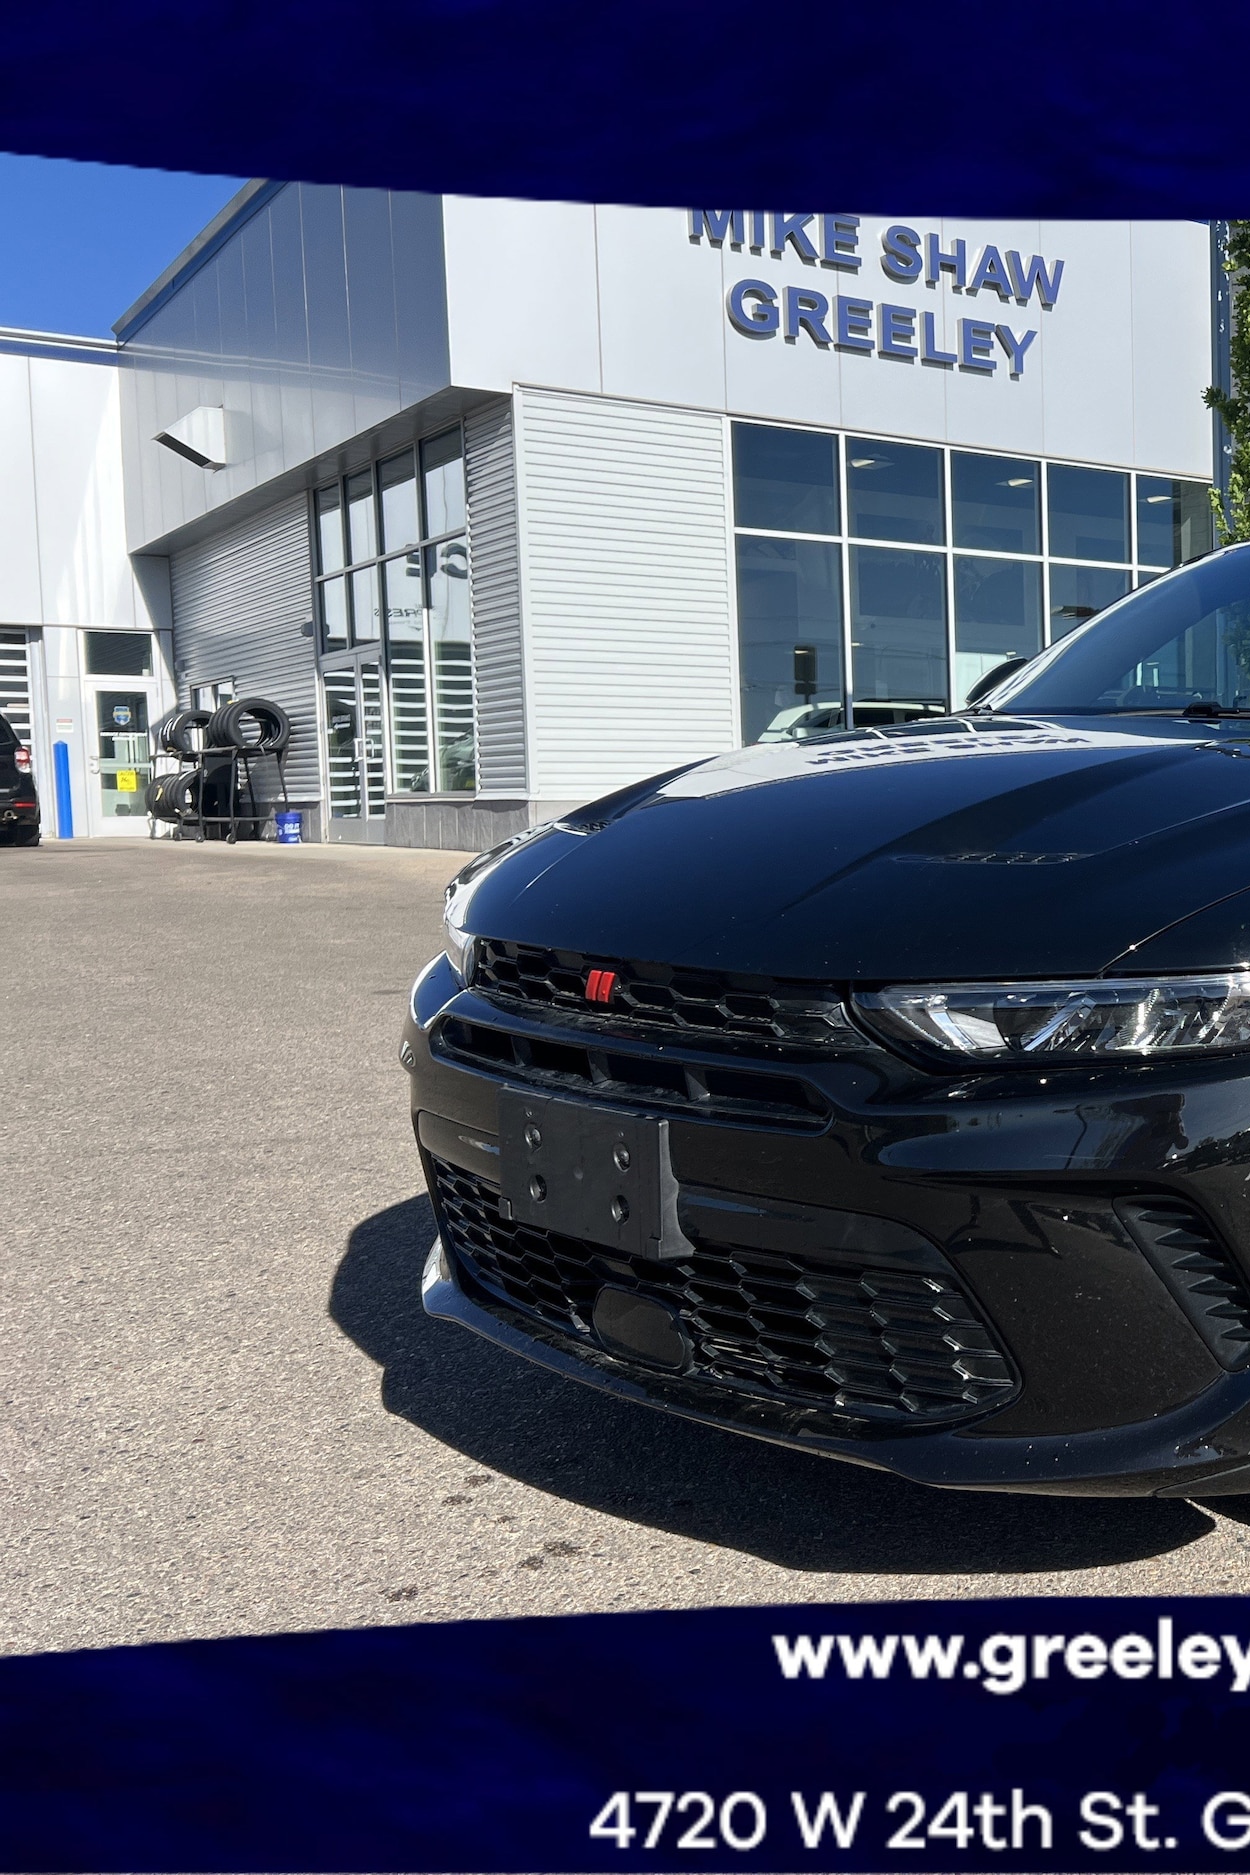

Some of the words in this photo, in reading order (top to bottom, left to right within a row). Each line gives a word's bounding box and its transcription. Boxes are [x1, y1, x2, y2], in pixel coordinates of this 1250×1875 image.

[687, 208, 862, 275] MIKE
[880, 224, 1065, 312] SHAW
[726, 278, 1037, 381] GREELEY
